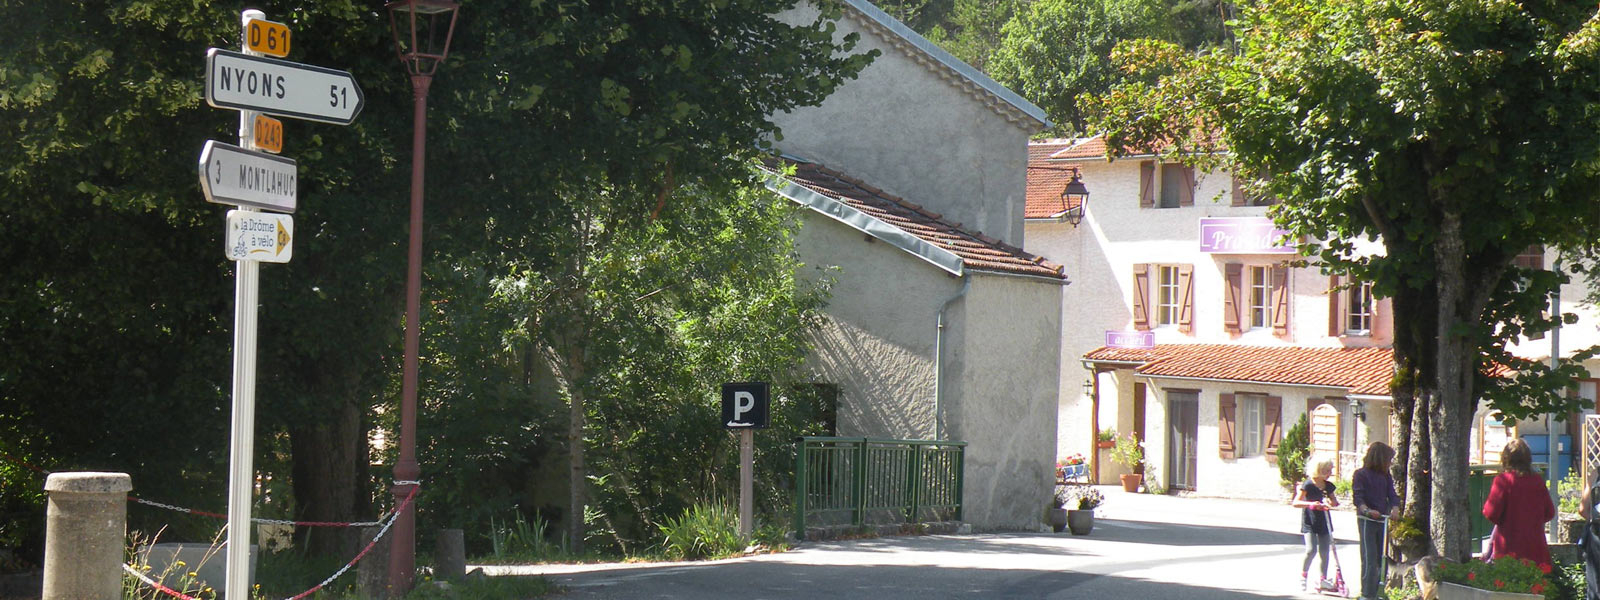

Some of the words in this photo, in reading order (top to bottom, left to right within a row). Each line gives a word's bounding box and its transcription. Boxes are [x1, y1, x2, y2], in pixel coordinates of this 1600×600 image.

[220, 66, 286, 99] NYONS
[329, 85, 347, 109] 51
[215, 160, 221, 185] 3
[239, 164, 295, 197] MONTLAHUC
[240, 218, 248, 231] la
[249, 218, 275, 233] Drôme
[251, 234, 256, 247] à
[257, 235, 274, 247] vélo
[734, 391, 755, 421] P
